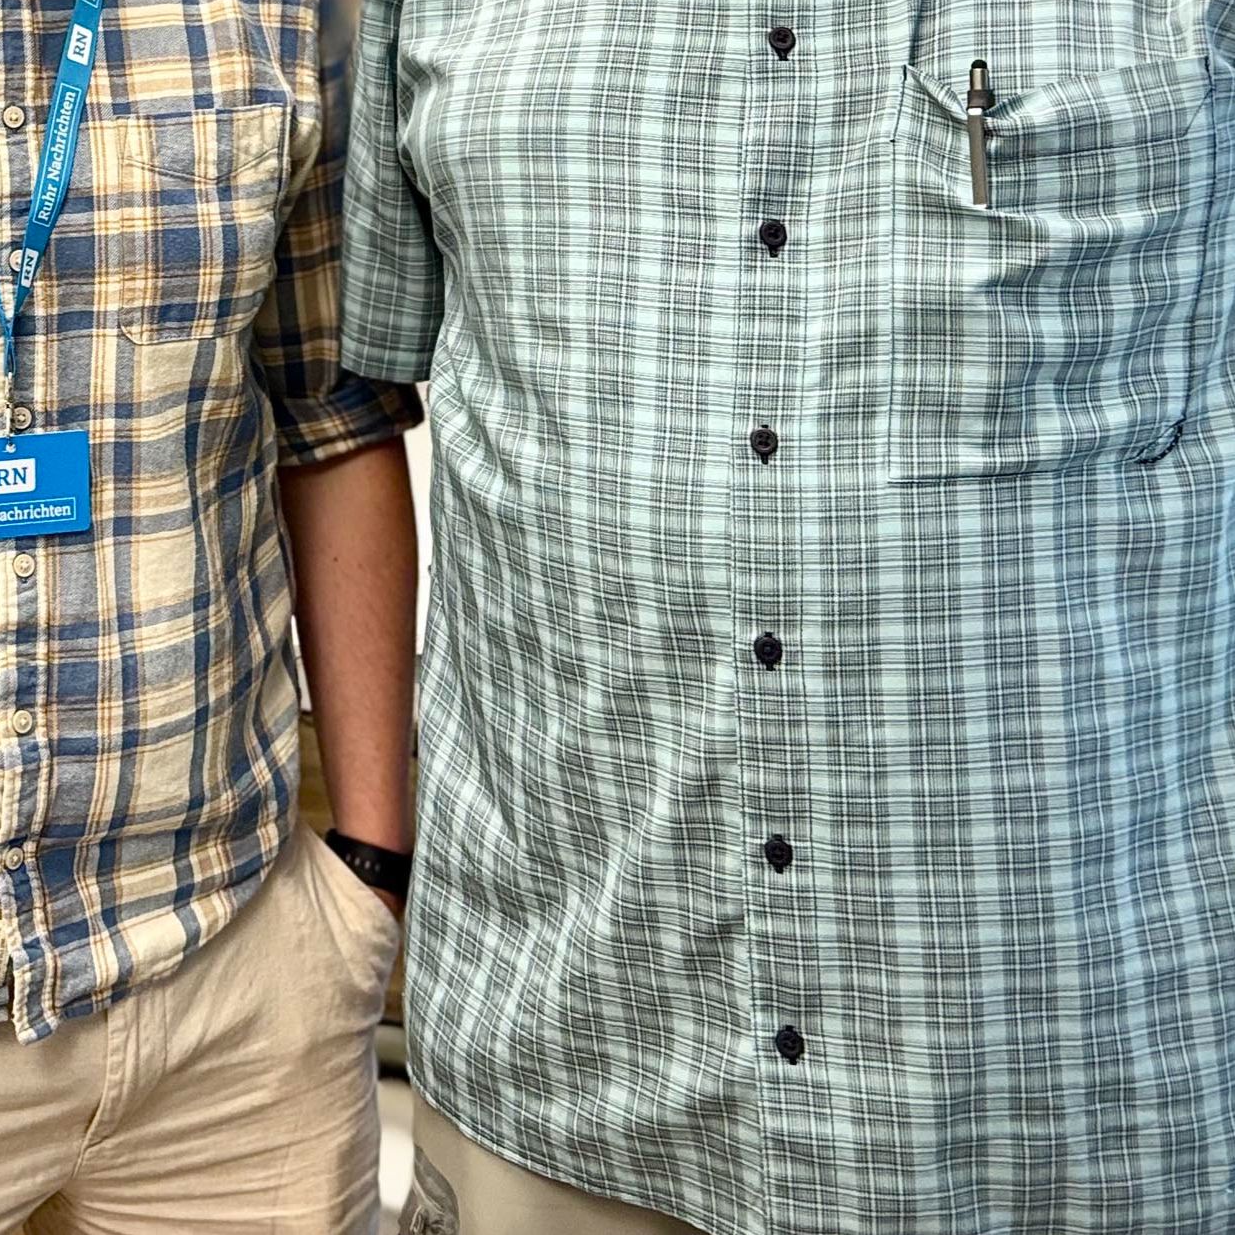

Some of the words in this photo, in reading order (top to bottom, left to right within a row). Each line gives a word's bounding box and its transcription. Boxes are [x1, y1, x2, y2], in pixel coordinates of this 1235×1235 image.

[72, 31, 88, 58] RN
[46, 91, 76, 187] Nachrichten
[37, 184, 58, 222] Ruhr
[23, 255, 35, 281] RN
